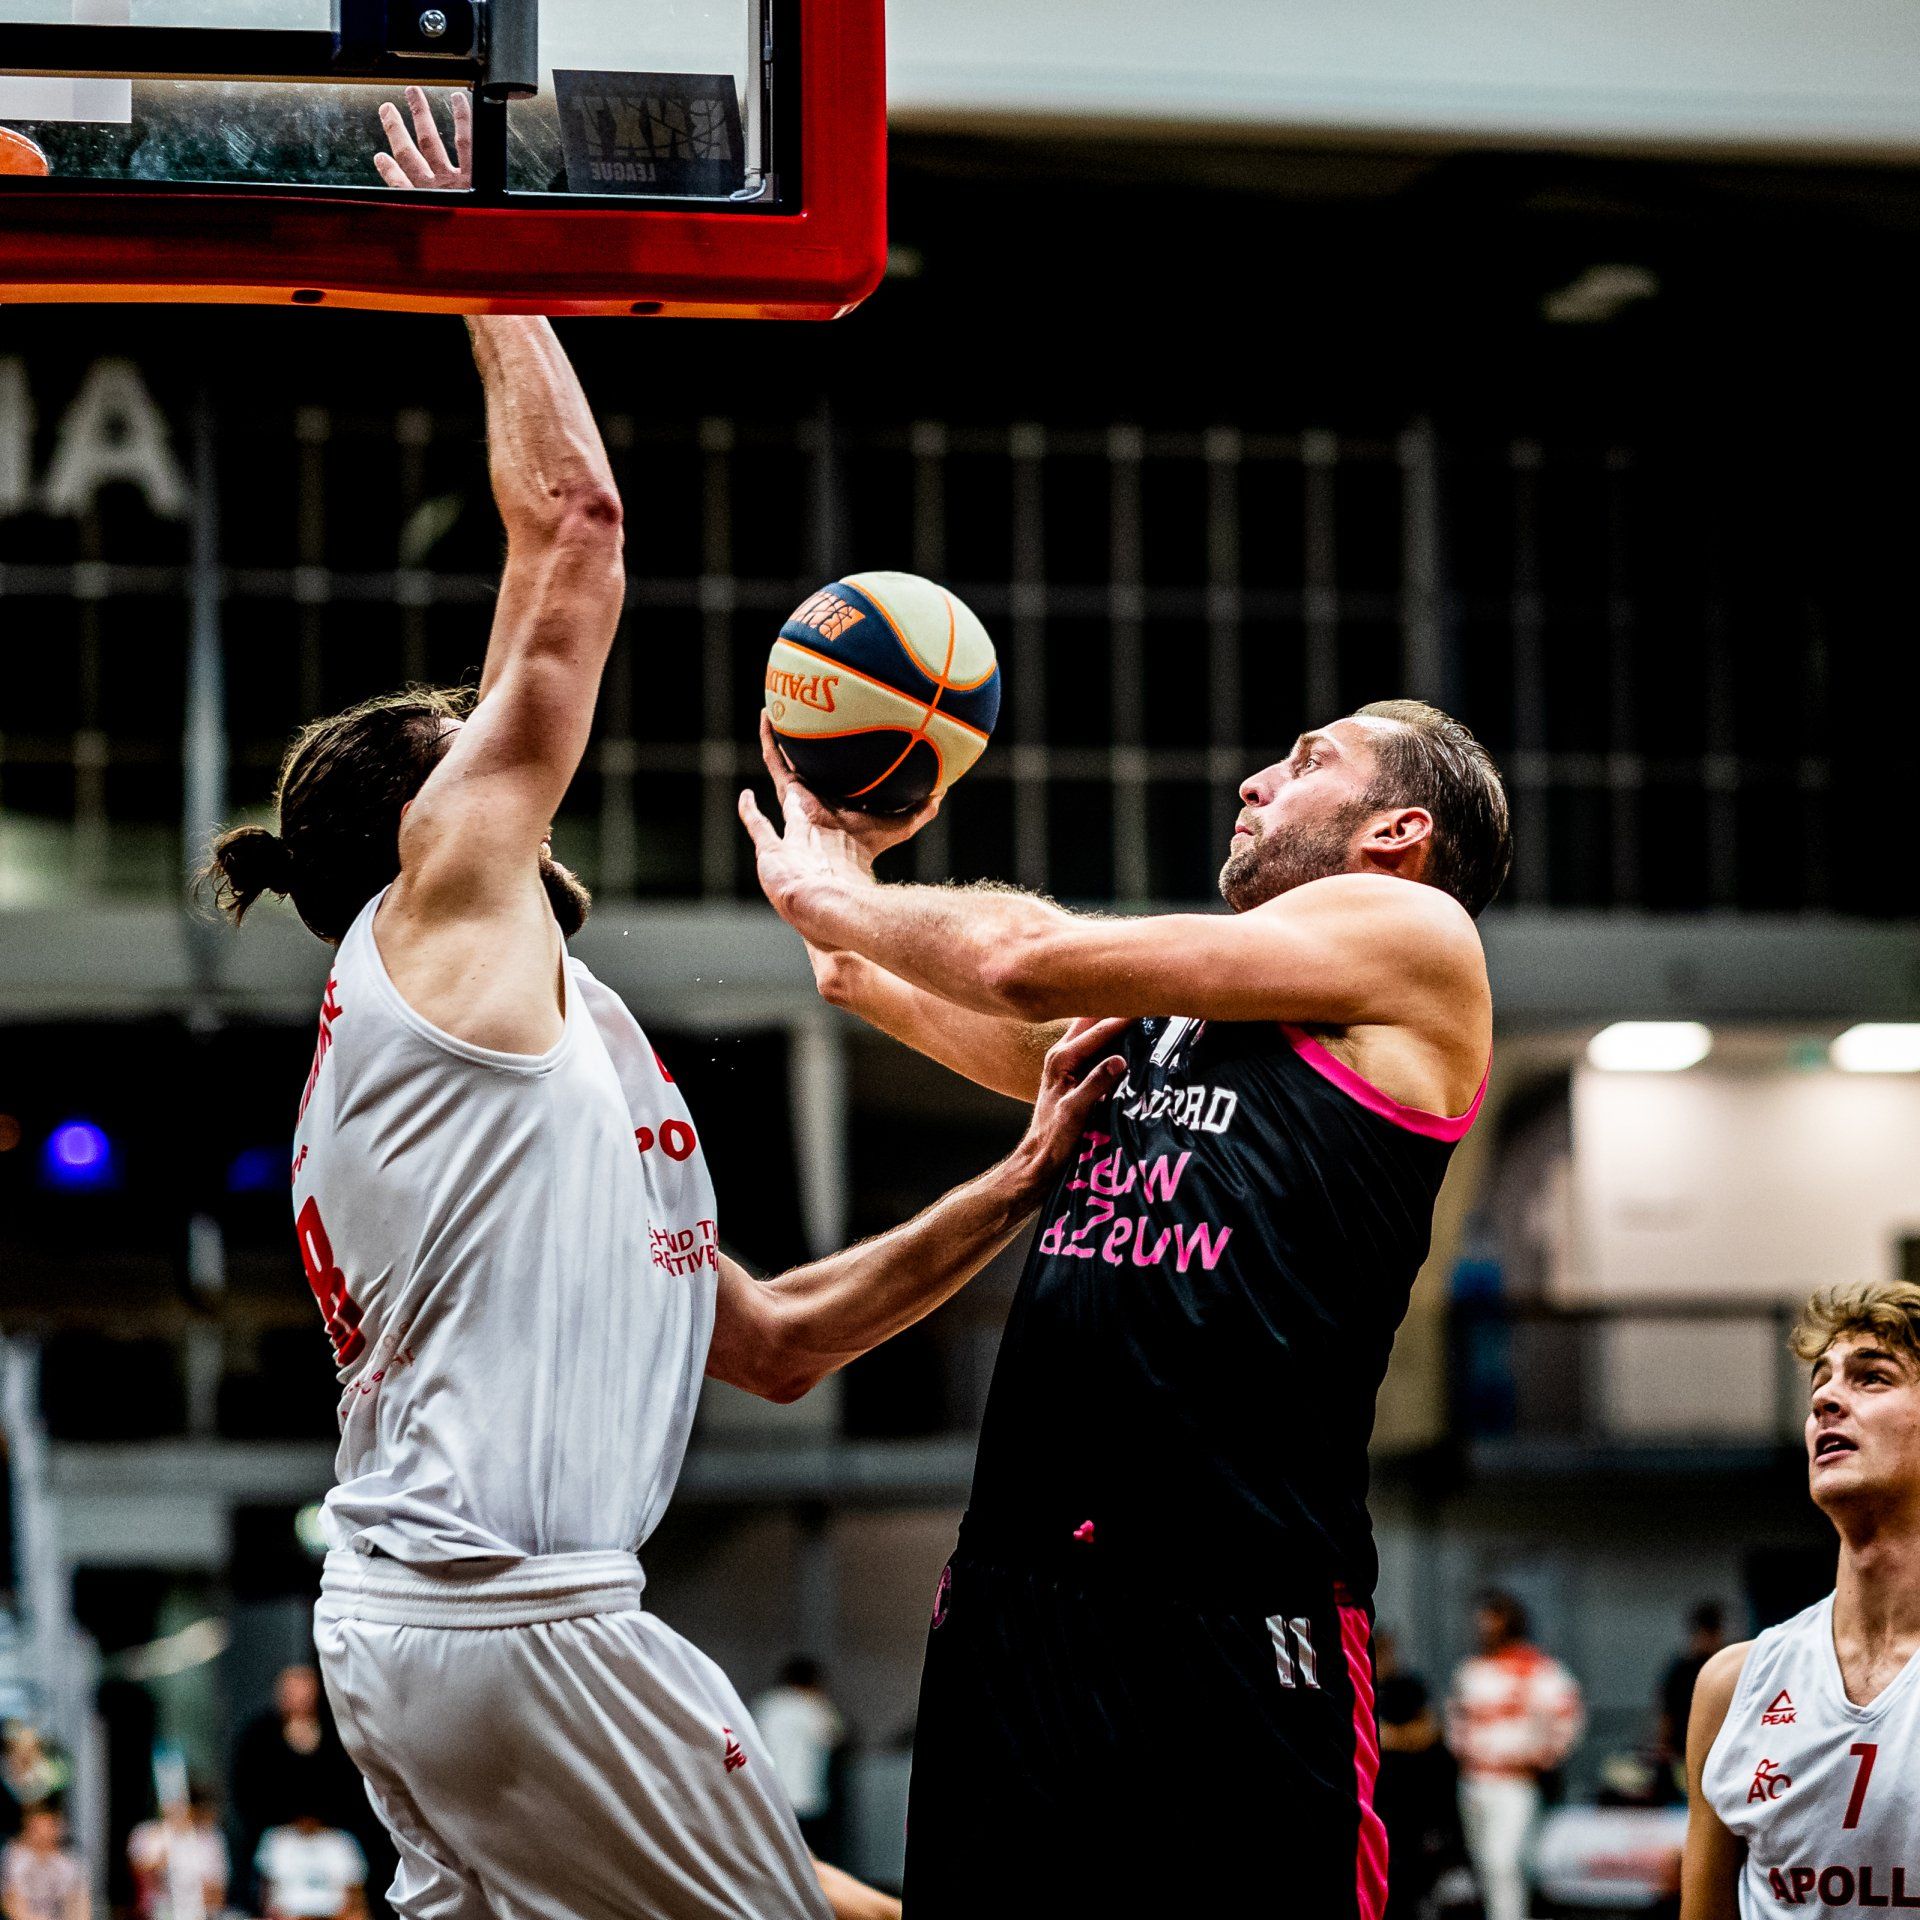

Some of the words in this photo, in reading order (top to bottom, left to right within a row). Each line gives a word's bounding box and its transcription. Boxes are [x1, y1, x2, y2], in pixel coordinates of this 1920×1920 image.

[1265, 1614, 1321, 1689] 11
[1760, 1711, 1798, 1727] PEAK
[1842, 1742, 1888, 1830] 7
